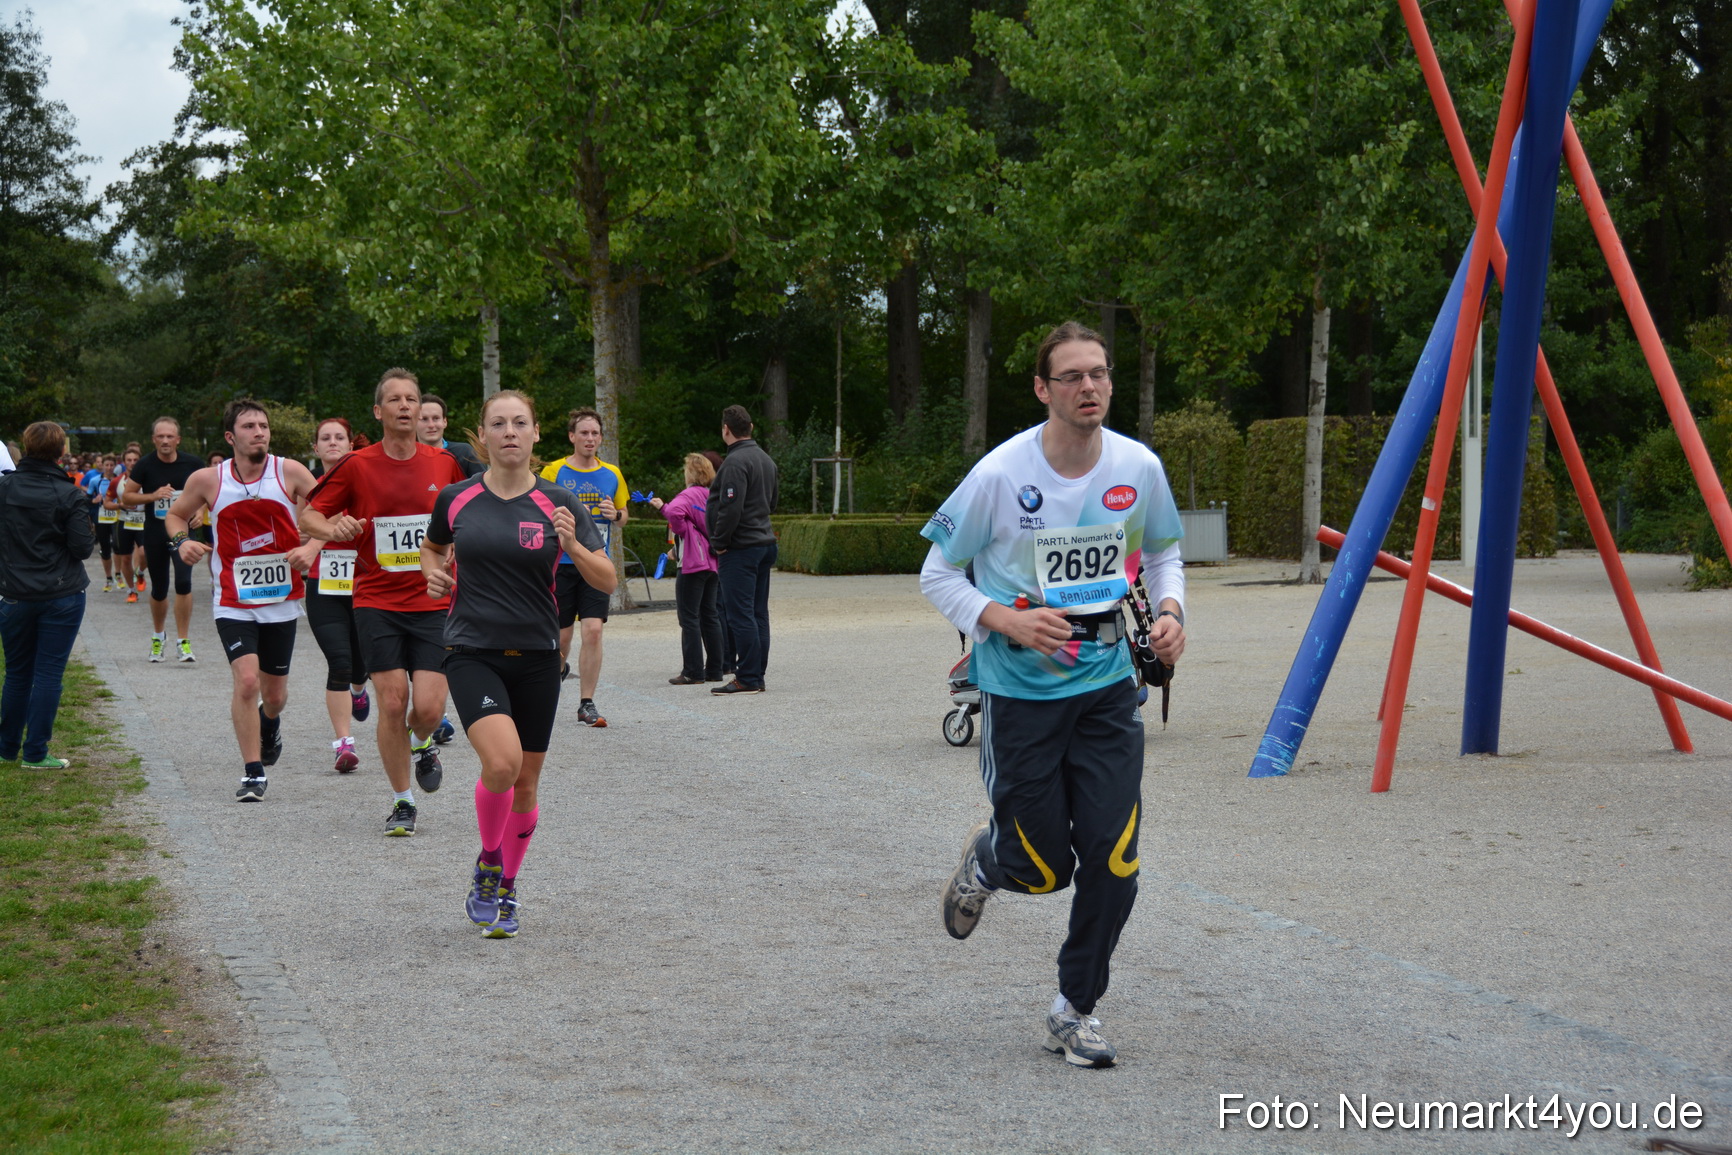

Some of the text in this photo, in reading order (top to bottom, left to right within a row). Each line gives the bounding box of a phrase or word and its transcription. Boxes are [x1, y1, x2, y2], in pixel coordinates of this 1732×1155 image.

[1107, 492, 1134, 504] Hervis
[1019, 516, 1045, 526] PARTL
[1037, 533, 1113, 547] PARTL Neumarkt
[1046, 545, 1119, 583] 2692
[241, 565, 286, 585] 2200
[252, 588, 279, 597] Michael
[1059, 586, 1113, 604] Benjamin
